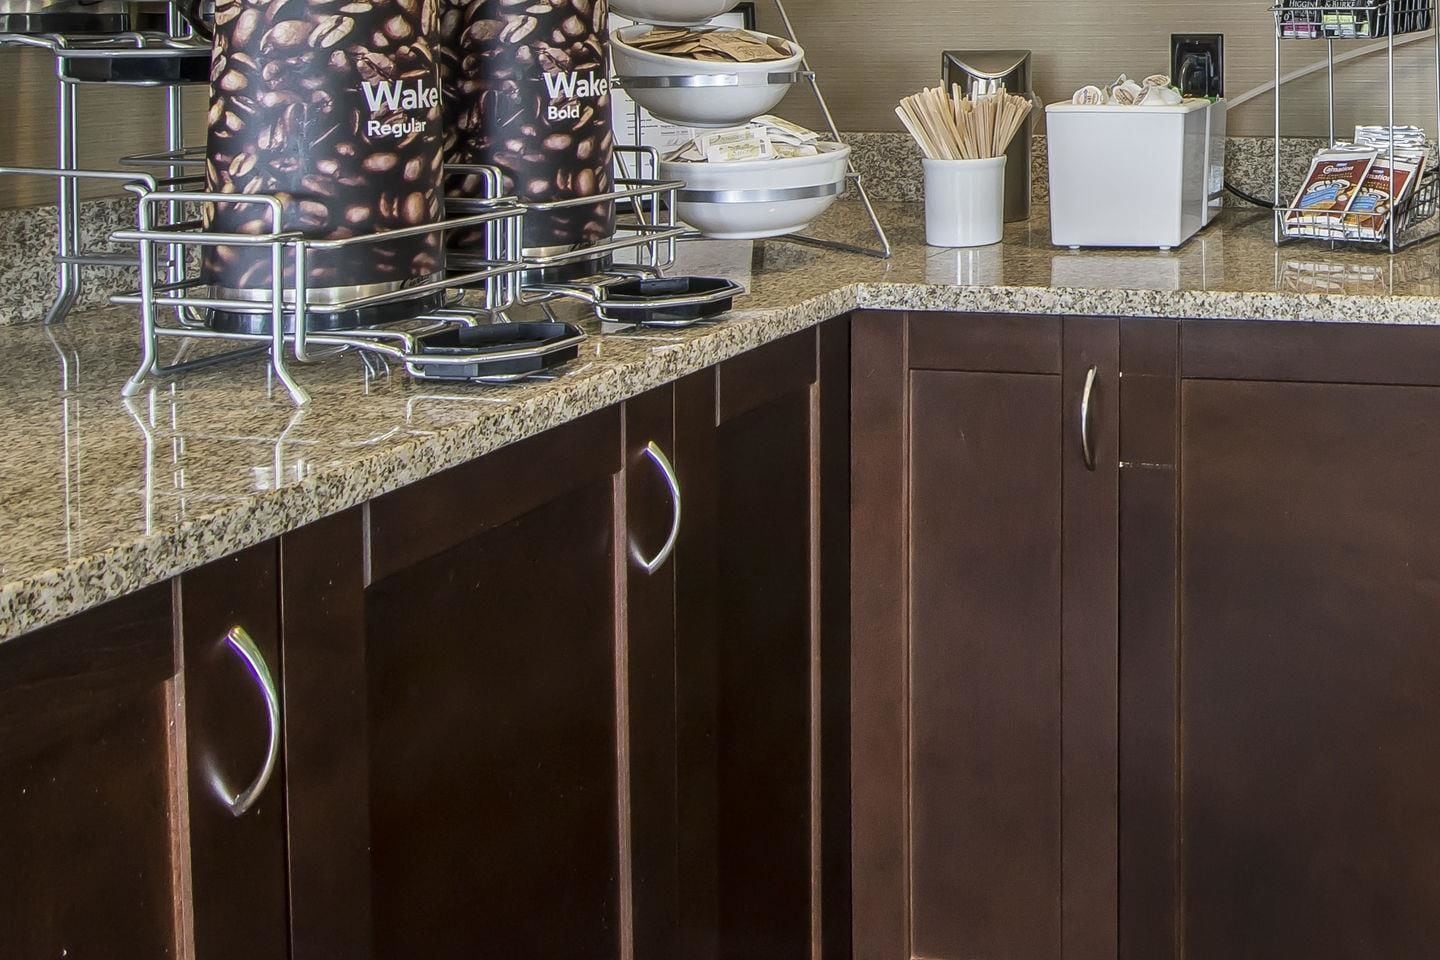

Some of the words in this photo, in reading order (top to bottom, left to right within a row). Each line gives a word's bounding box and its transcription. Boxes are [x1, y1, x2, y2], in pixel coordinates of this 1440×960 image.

[361, 79, 439, 112] Wake
[543, 71, 608, 99] Wake
[547, 106, 580, 120] Bold
[367, 118, 427, 138] Regular
